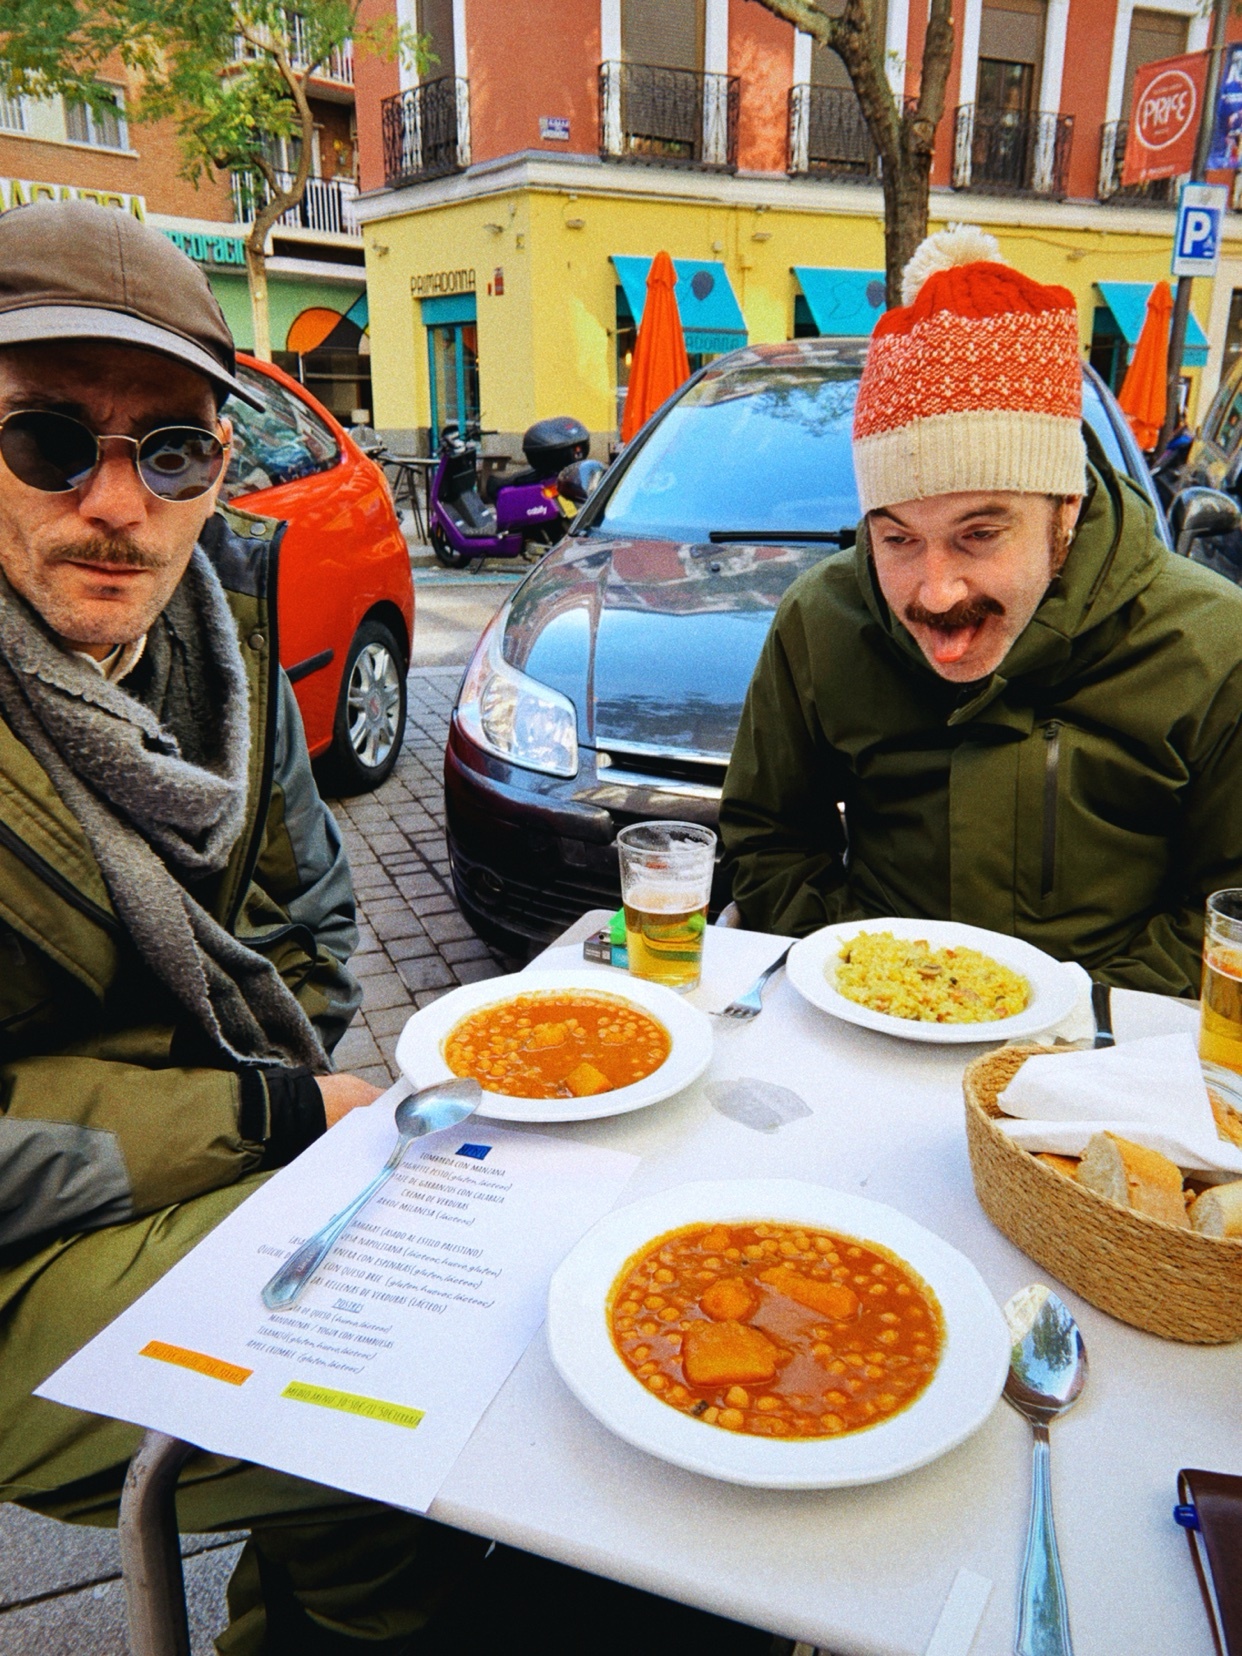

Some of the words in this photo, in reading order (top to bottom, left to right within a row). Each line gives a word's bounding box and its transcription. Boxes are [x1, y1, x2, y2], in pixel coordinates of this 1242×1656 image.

[1183, 211, 1211, 255] P
[411, 268, 476, 296] PRIMADONNA
[471, 1165, 506, 1177] MANZANA
